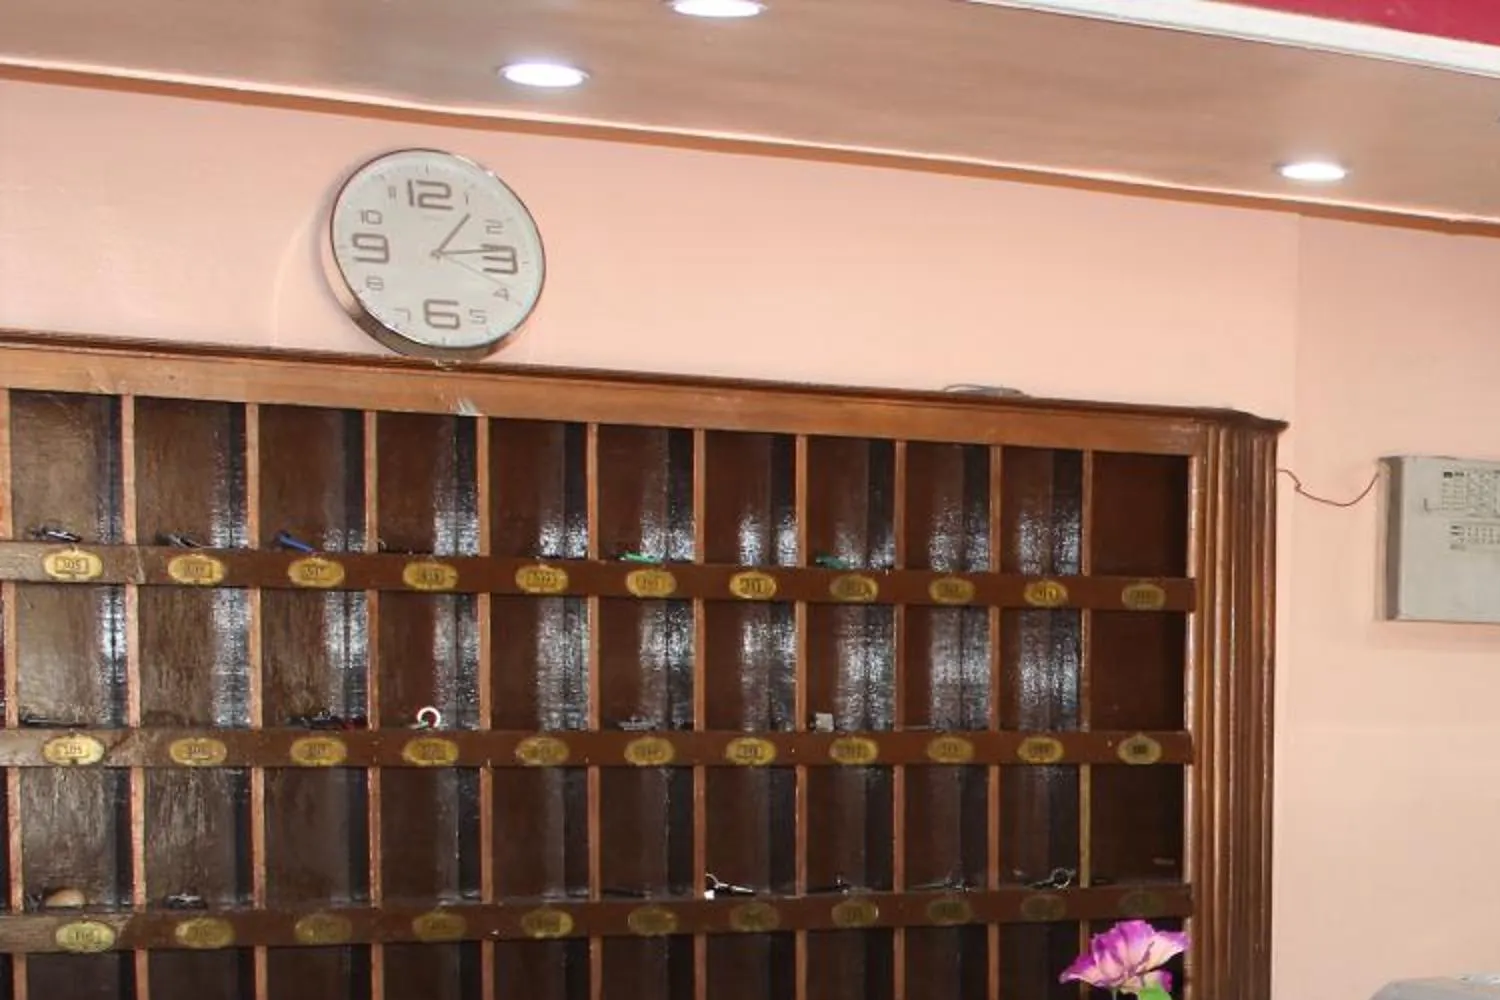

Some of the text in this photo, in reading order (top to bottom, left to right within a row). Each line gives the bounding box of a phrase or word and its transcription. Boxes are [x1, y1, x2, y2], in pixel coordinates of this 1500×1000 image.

[407, 179, 454, 210] 12
[360, 209, 383, 225] 10
[485, 219, 504, 235] 2
[352, 233, 390, 264] 9
[481, 243, 518, 275] 3
[366, 276, 384, 291] 8
[493, 288, 510, 302] 4
[395, 307, 412, 322] 7
[423, 299, 461, 330] 6
[469, 309, 487, 325] 5
